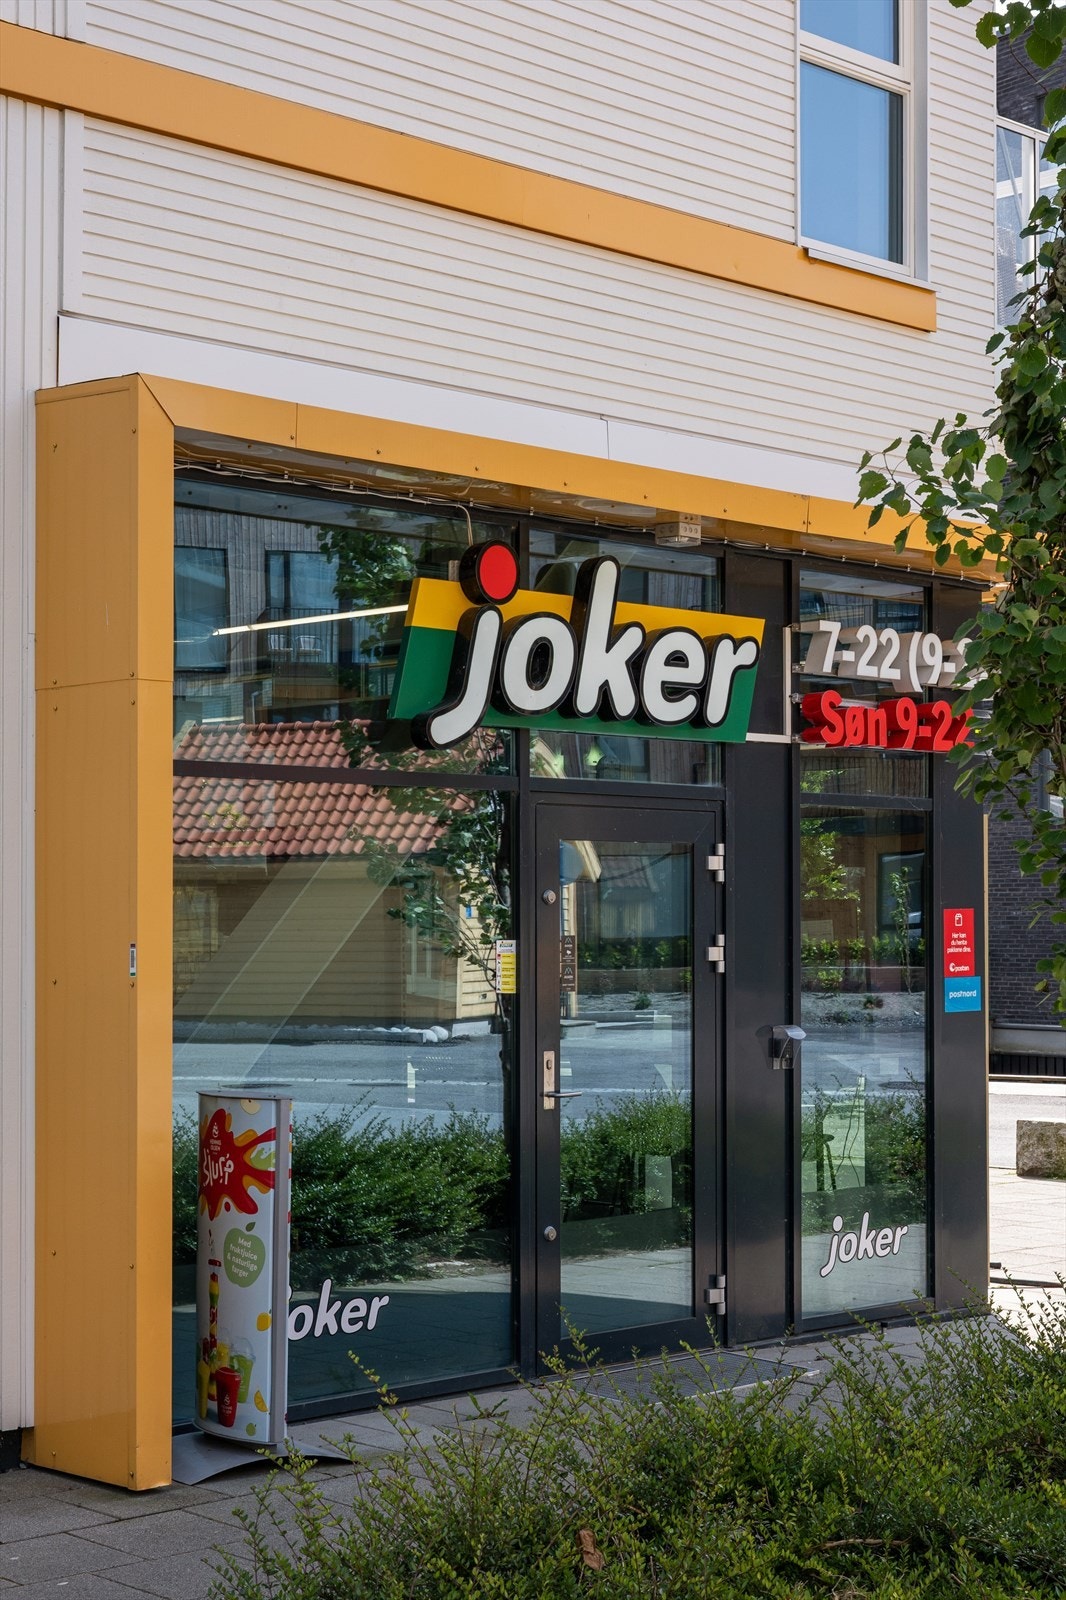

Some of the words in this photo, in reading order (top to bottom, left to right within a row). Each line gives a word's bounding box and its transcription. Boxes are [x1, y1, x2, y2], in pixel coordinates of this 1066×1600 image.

[411, 538, 761, 751] joker
[808, 619, 901, 681] 7-22
[811, 690, 888, 748] Søn
[949, 990, 976, 1000] postnord
[238, 1237, 252, 1249] Med
[819, 1210, 908, 1278] joker
[288, 1277, 391, 1342] oker
